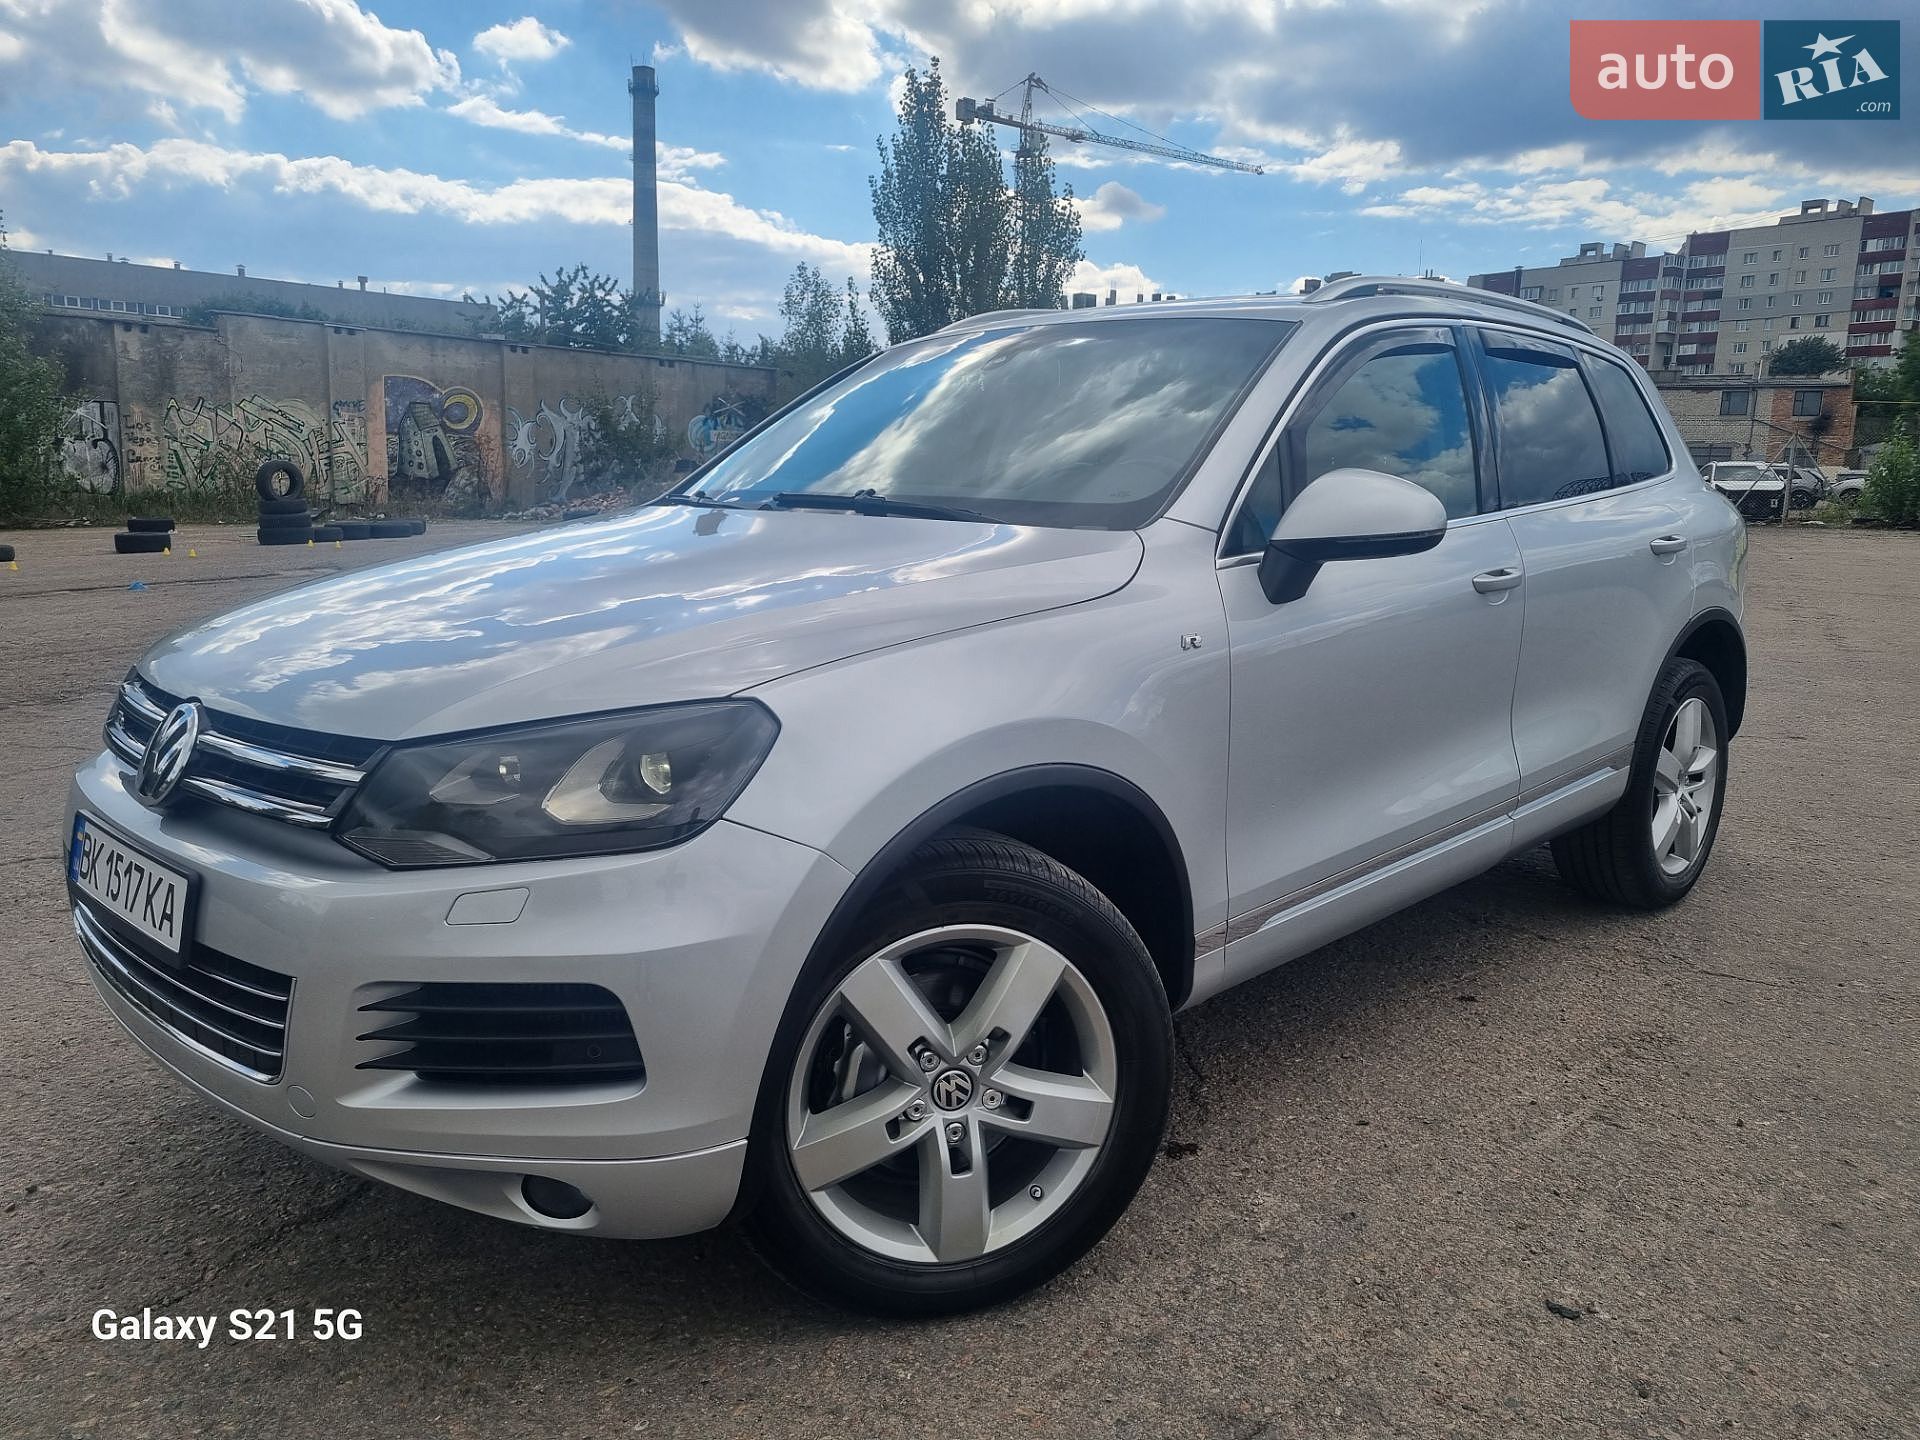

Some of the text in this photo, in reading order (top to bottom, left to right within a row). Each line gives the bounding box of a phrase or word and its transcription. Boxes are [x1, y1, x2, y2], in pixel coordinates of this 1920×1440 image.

[79, 832, 175, 938] BK 1517 KA
